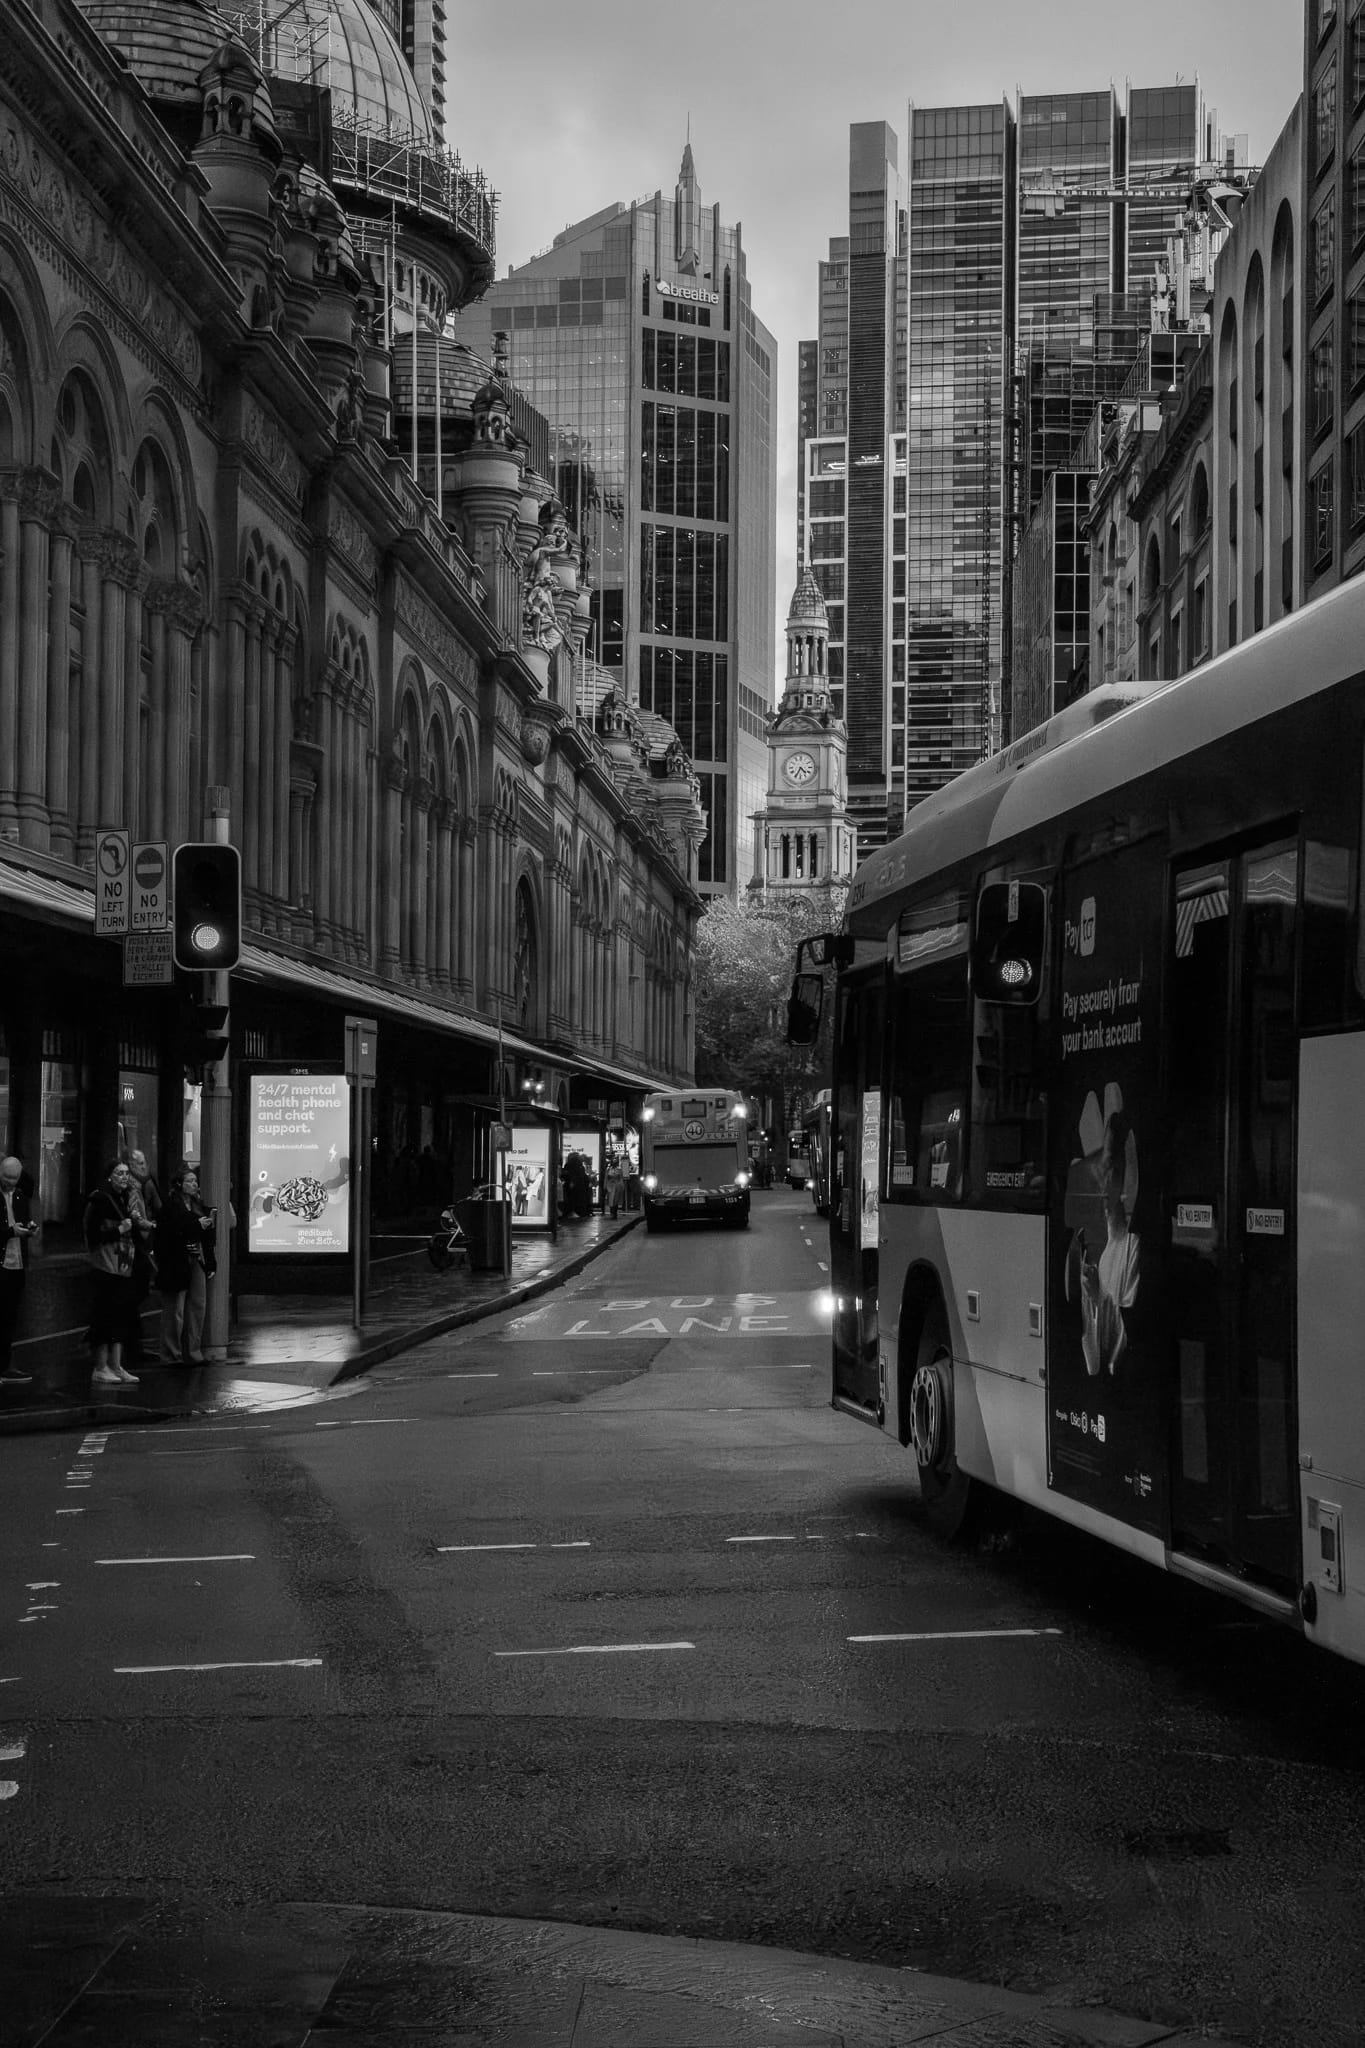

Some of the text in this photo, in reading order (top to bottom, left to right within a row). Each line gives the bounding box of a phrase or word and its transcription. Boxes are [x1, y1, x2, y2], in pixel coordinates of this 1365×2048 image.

[670, 281, 719, 304] breathe
[104, 882, 122, 897] NO
[101, 901, 124, 912] LEFT
[140, 894, 158, 907] NO
[101, 916, 125, 927] TURN
[134, 911, 164, 923] ENTRY
[1063, 991, 1079, 1023] Pay
[1079, 979, 1117, 1015] securely
[1062, 1031, 1081, 1061] your
[1081, 1020, 1104, 1051] bank
[258, 1083, 336, 1096] 24/7 mental
[258, 1096, 341, 1110] health phone
[258, 1109, 315, 1120] and chat
[257, 1123, 311, 1136] support.
[686, 1125, 702, 1136] 40
[1185, 1210, 1211, 1223] NO ENTRY
[1255, 1215, 1282, 1228] NO ENTRY
[297, 1228, 333, 1237] medibank
[599, 1293, 777, 1313] BUS
[563, 1315, 790, 1336] LANE
